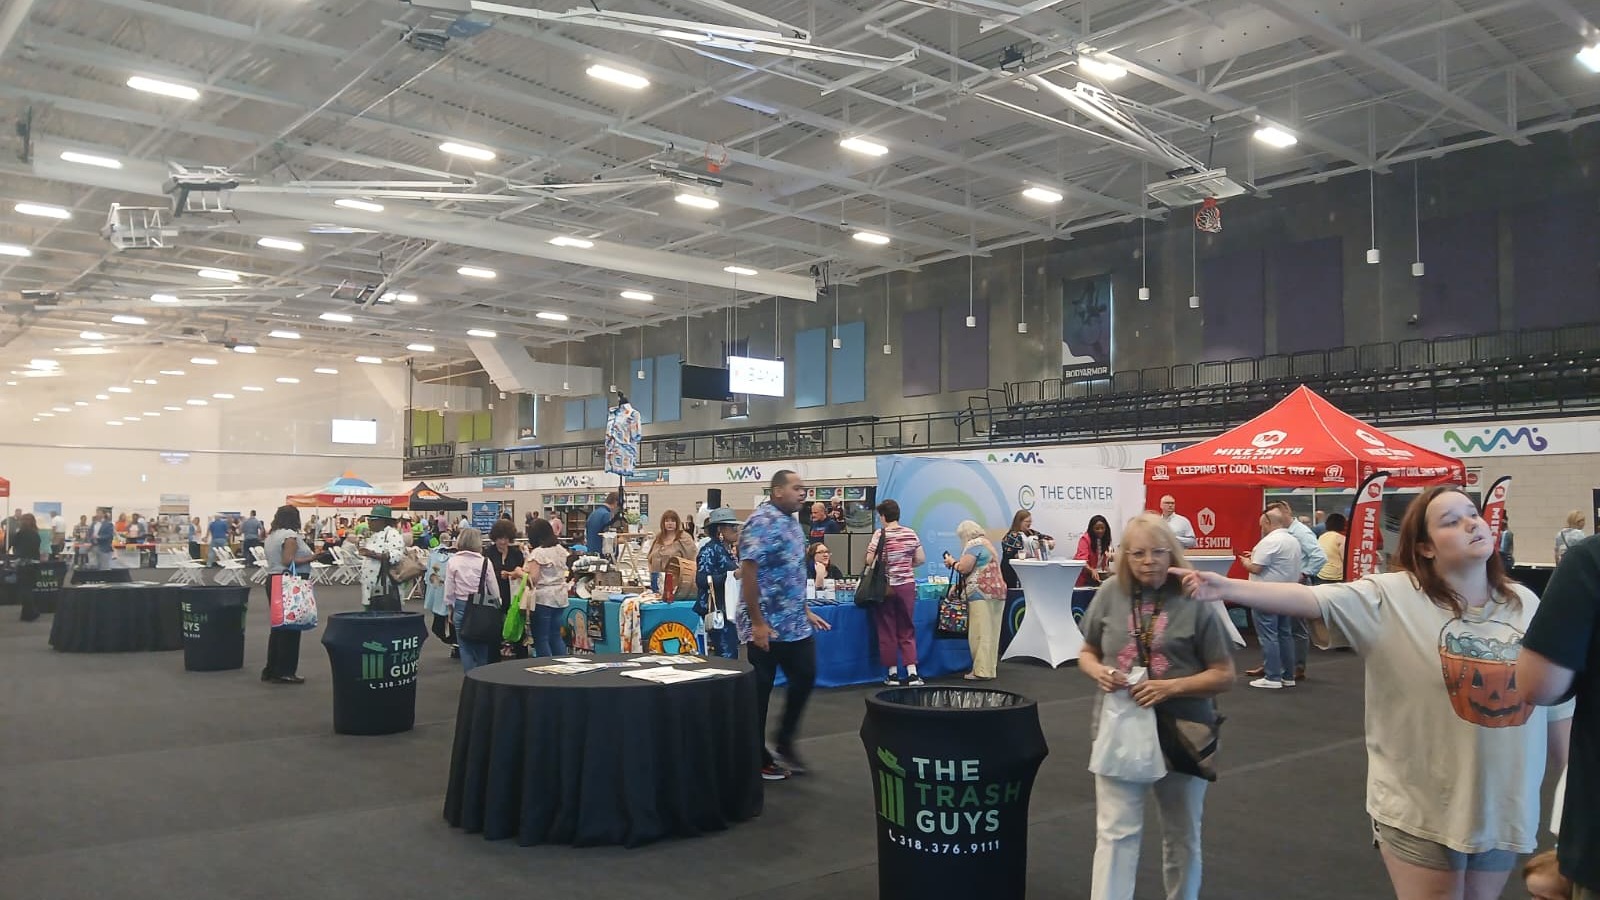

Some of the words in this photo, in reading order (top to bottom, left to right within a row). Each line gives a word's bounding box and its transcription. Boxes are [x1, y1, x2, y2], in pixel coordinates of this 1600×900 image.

[1065, 366, 1108, 378] BODYARMOR
[1213, 448, 1254, 456] MIKE
[1254, 447, 1304, 456] SMITH
[1176, 465, 1217, 475] KEEPING
[1217, 464, 1228, 475] IT
[1229, 464, 1255, 474] COOL
[1256, 465, 1286, 475] SINCE
[1040, 485, 1065, 500] THE
[1067, 486, 1113, 500] CENTER
[347, 495, 393, 506] Manpower
[1362, 507, 1376, 550] MIKE
[1195, 537, 1204, 548] KE
[1204, 537, 1231, 548] SMITH
[391, 636, 419, 651] THE
[912, 757, 980, 782] THE
[914, 781, 1021, 808] TRASH
[916, 809, 1000, 835] GUYS
[900, 835, 1000, 855] 318.376.9111
